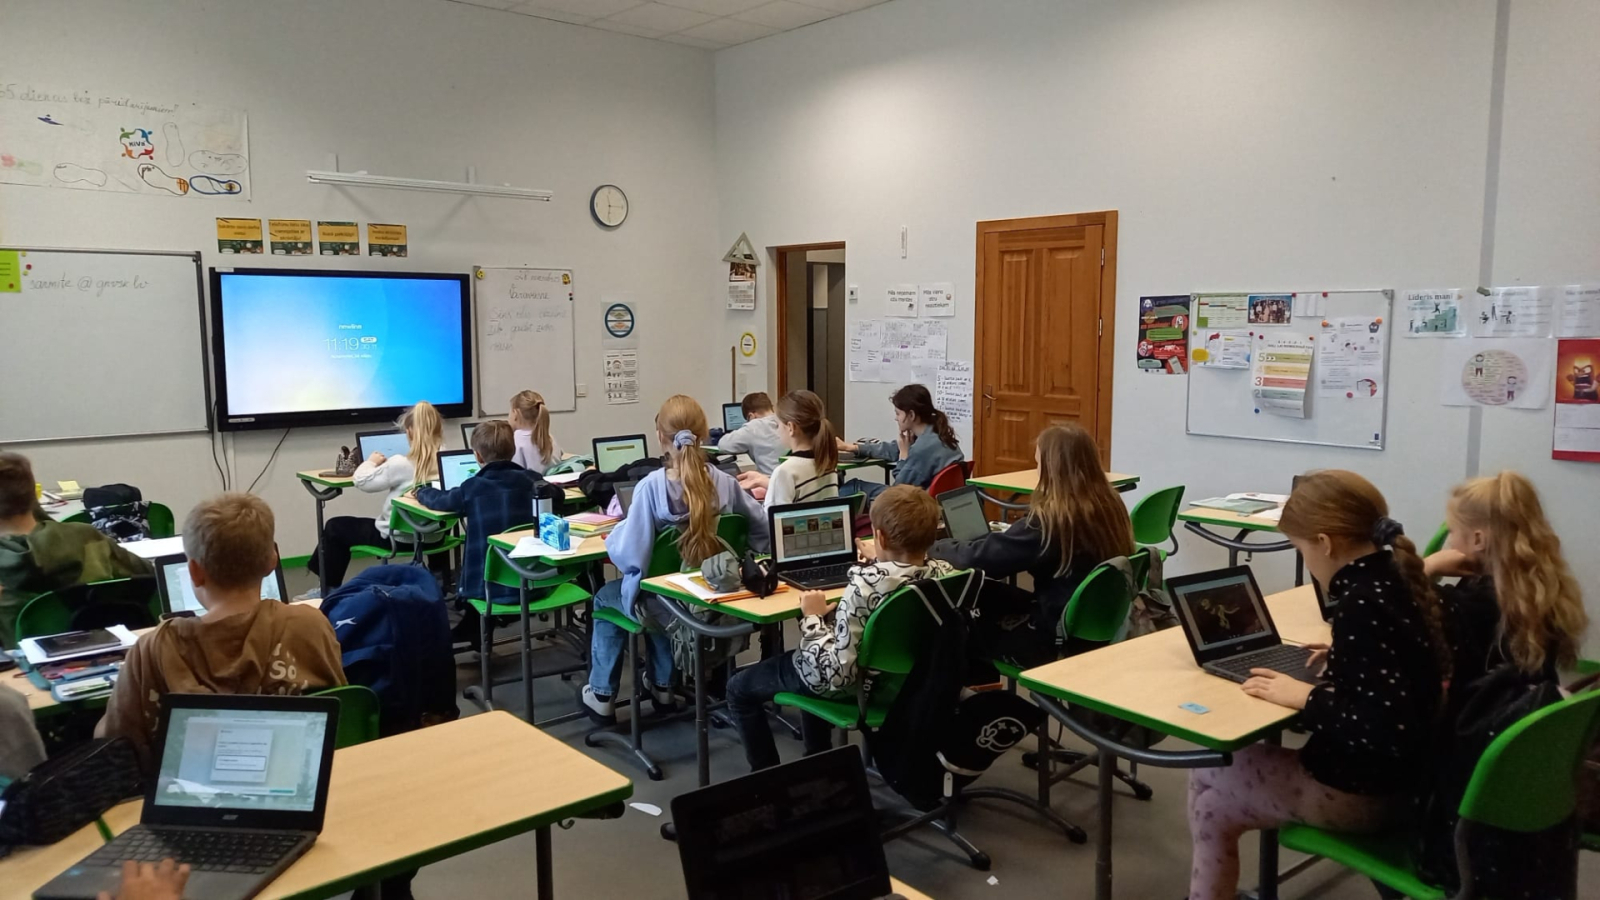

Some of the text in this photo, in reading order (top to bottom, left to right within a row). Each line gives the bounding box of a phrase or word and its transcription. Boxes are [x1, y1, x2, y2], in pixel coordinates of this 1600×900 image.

[77, 276, 92, 291] @
[322, 337, 359, 351] 11:19
[1254, 376, 1263, 387] 3
[1254, 389, 1262, 399] 2
